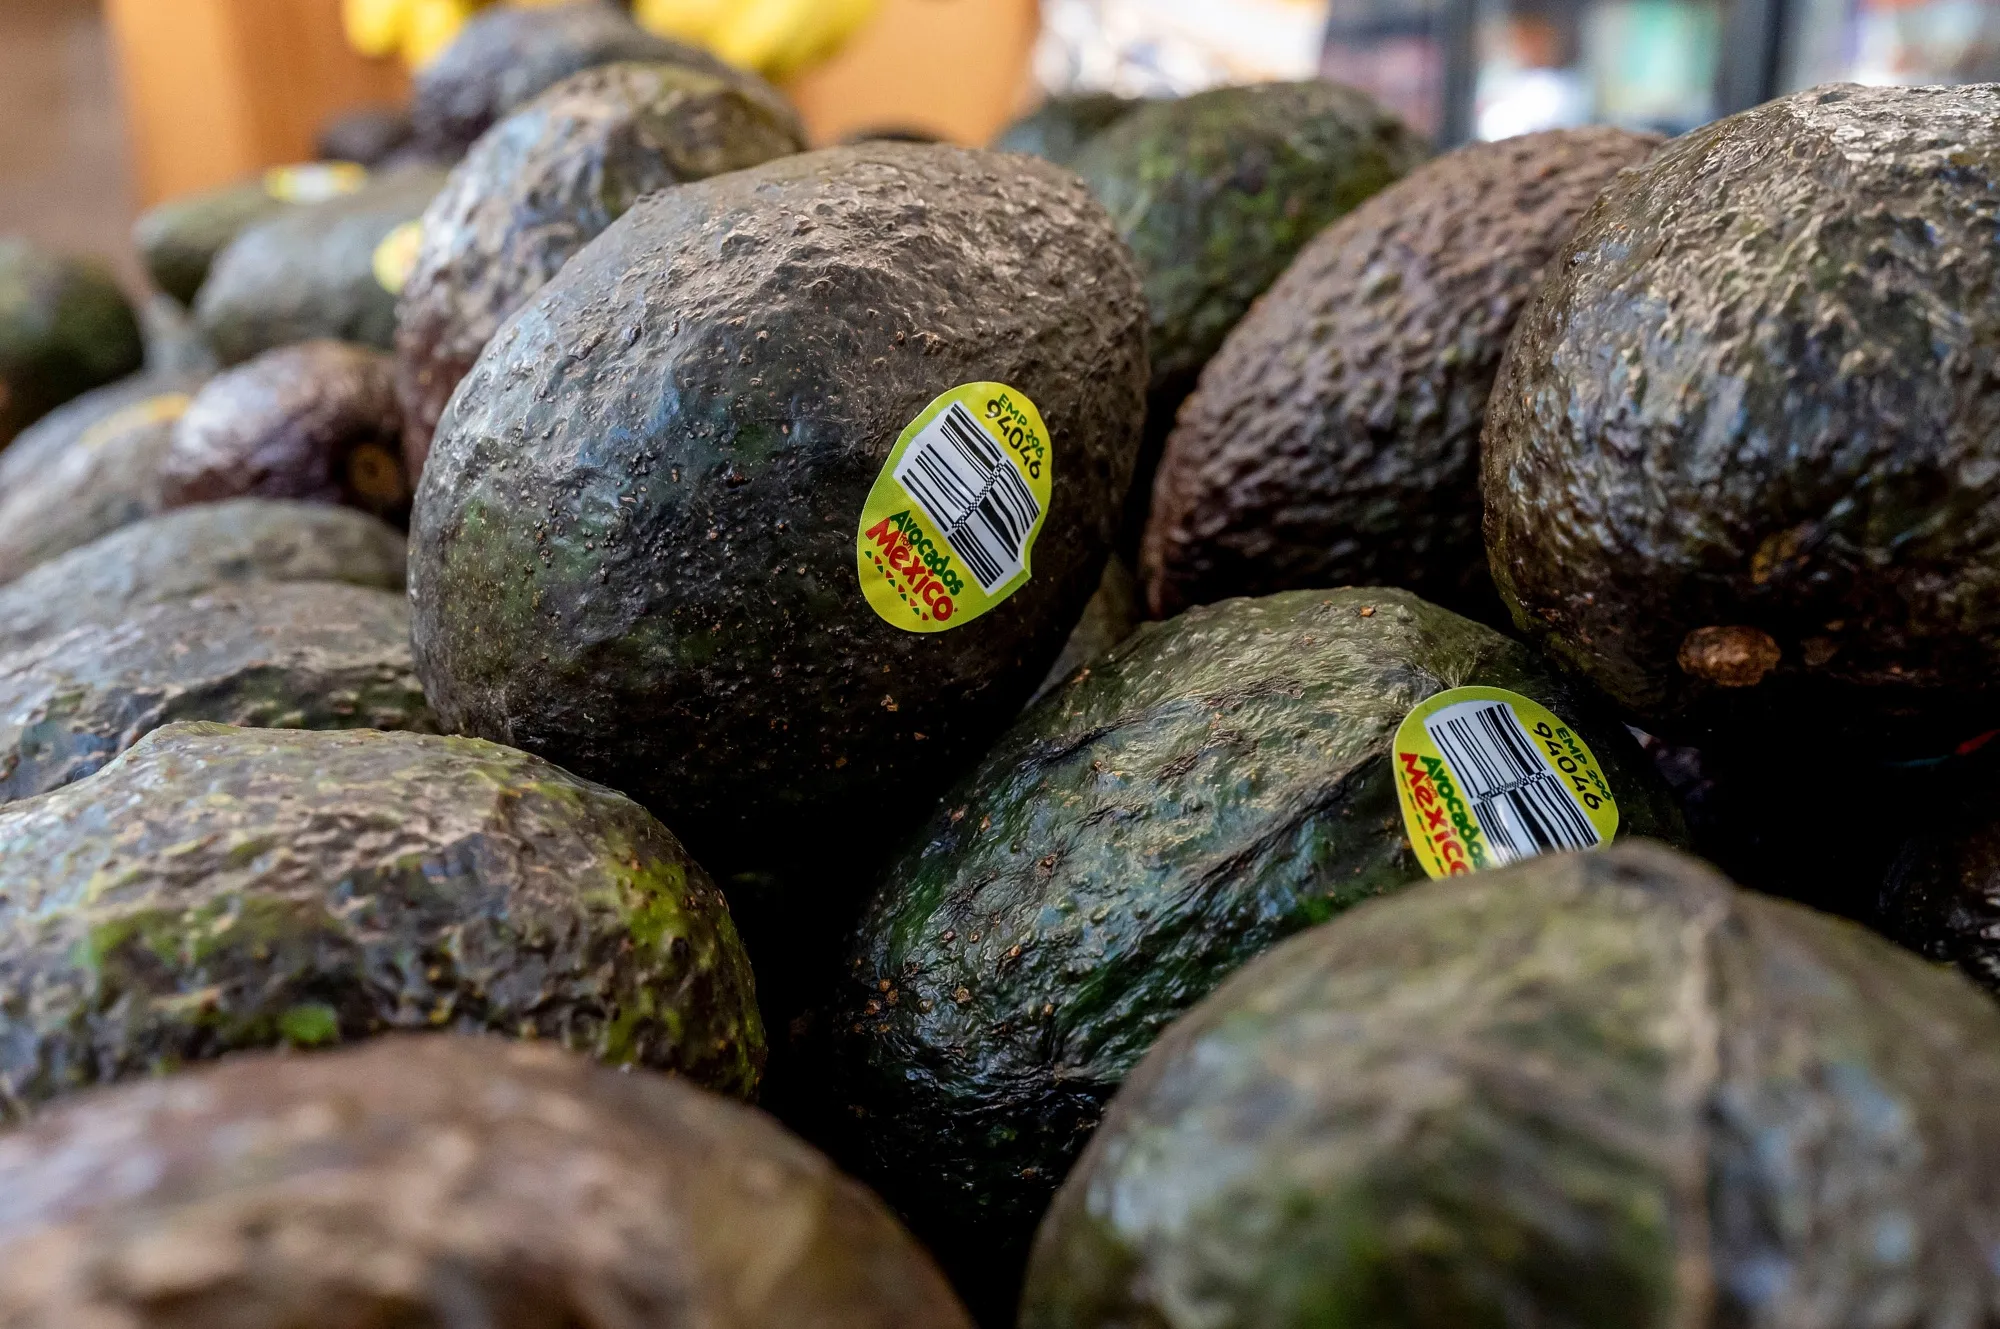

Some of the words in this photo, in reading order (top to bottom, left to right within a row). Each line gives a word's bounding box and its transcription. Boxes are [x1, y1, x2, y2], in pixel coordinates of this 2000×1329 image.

[984, 399, 1041, 480] 94046
[997, 393, 1028, 427] EMP
[1025, 429, 1044, 461] 296
[865, 517, 954, 622] Mexico
[889, 510, 965, 596] Avocados
[1532, 722, 1603, 810] 94046
[1555, 726, 1587, 766] EMP
[1585, 769, 1613, 802] 296
